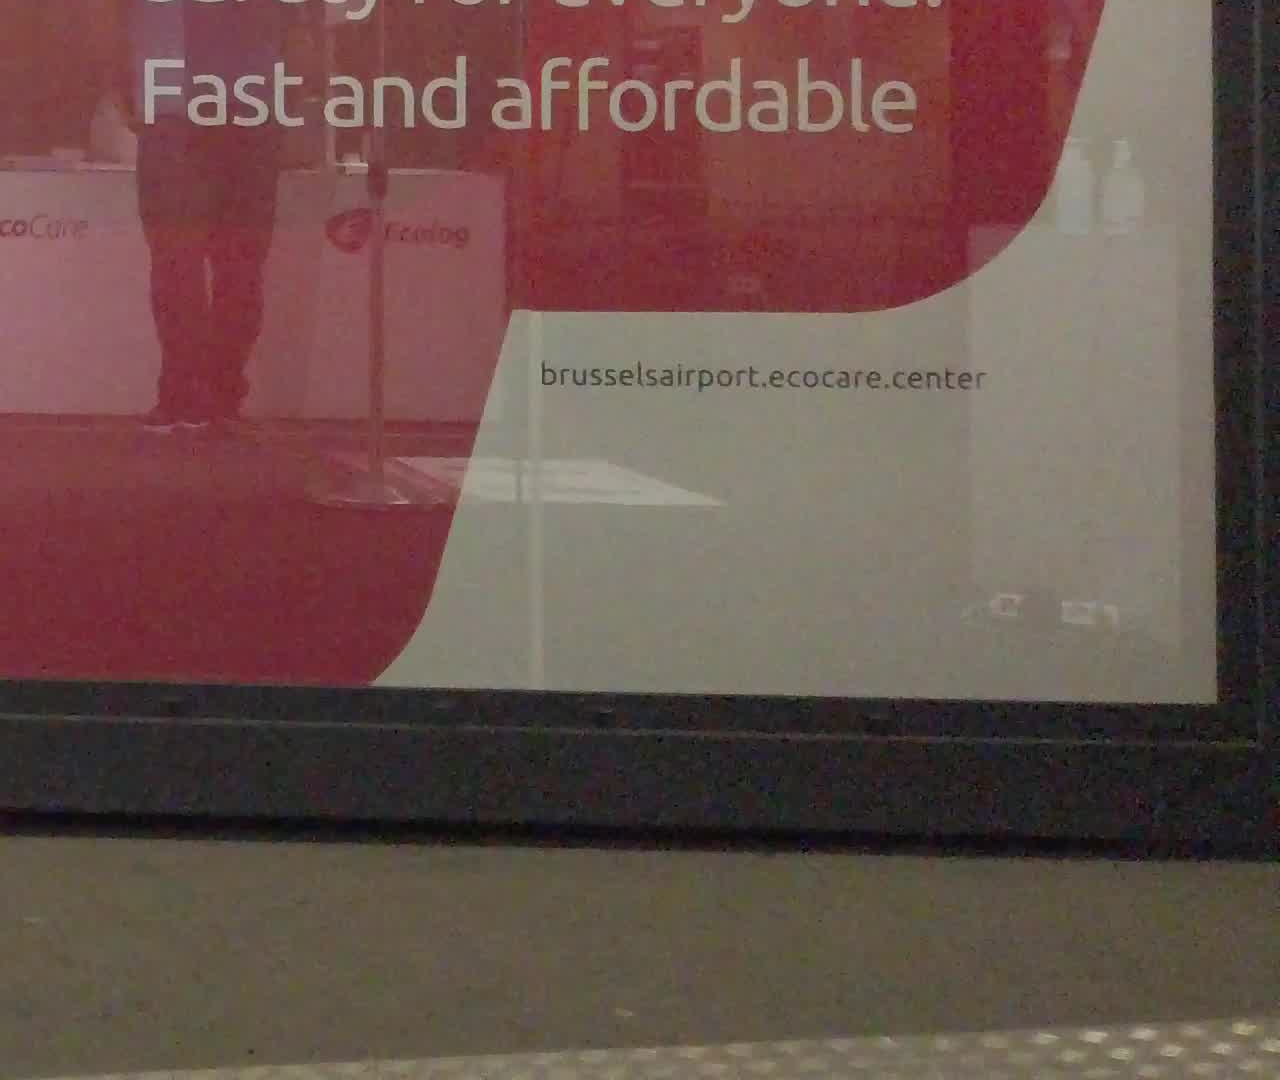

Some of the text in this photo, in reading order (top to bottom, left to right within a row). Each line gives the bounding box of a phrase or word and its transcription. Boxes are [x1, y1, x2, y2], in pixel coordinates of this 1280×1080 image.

[143, 56, 918, 133] Fast and affordable
[541, 360, 988, 392] brusselsairport.ecocare.center
